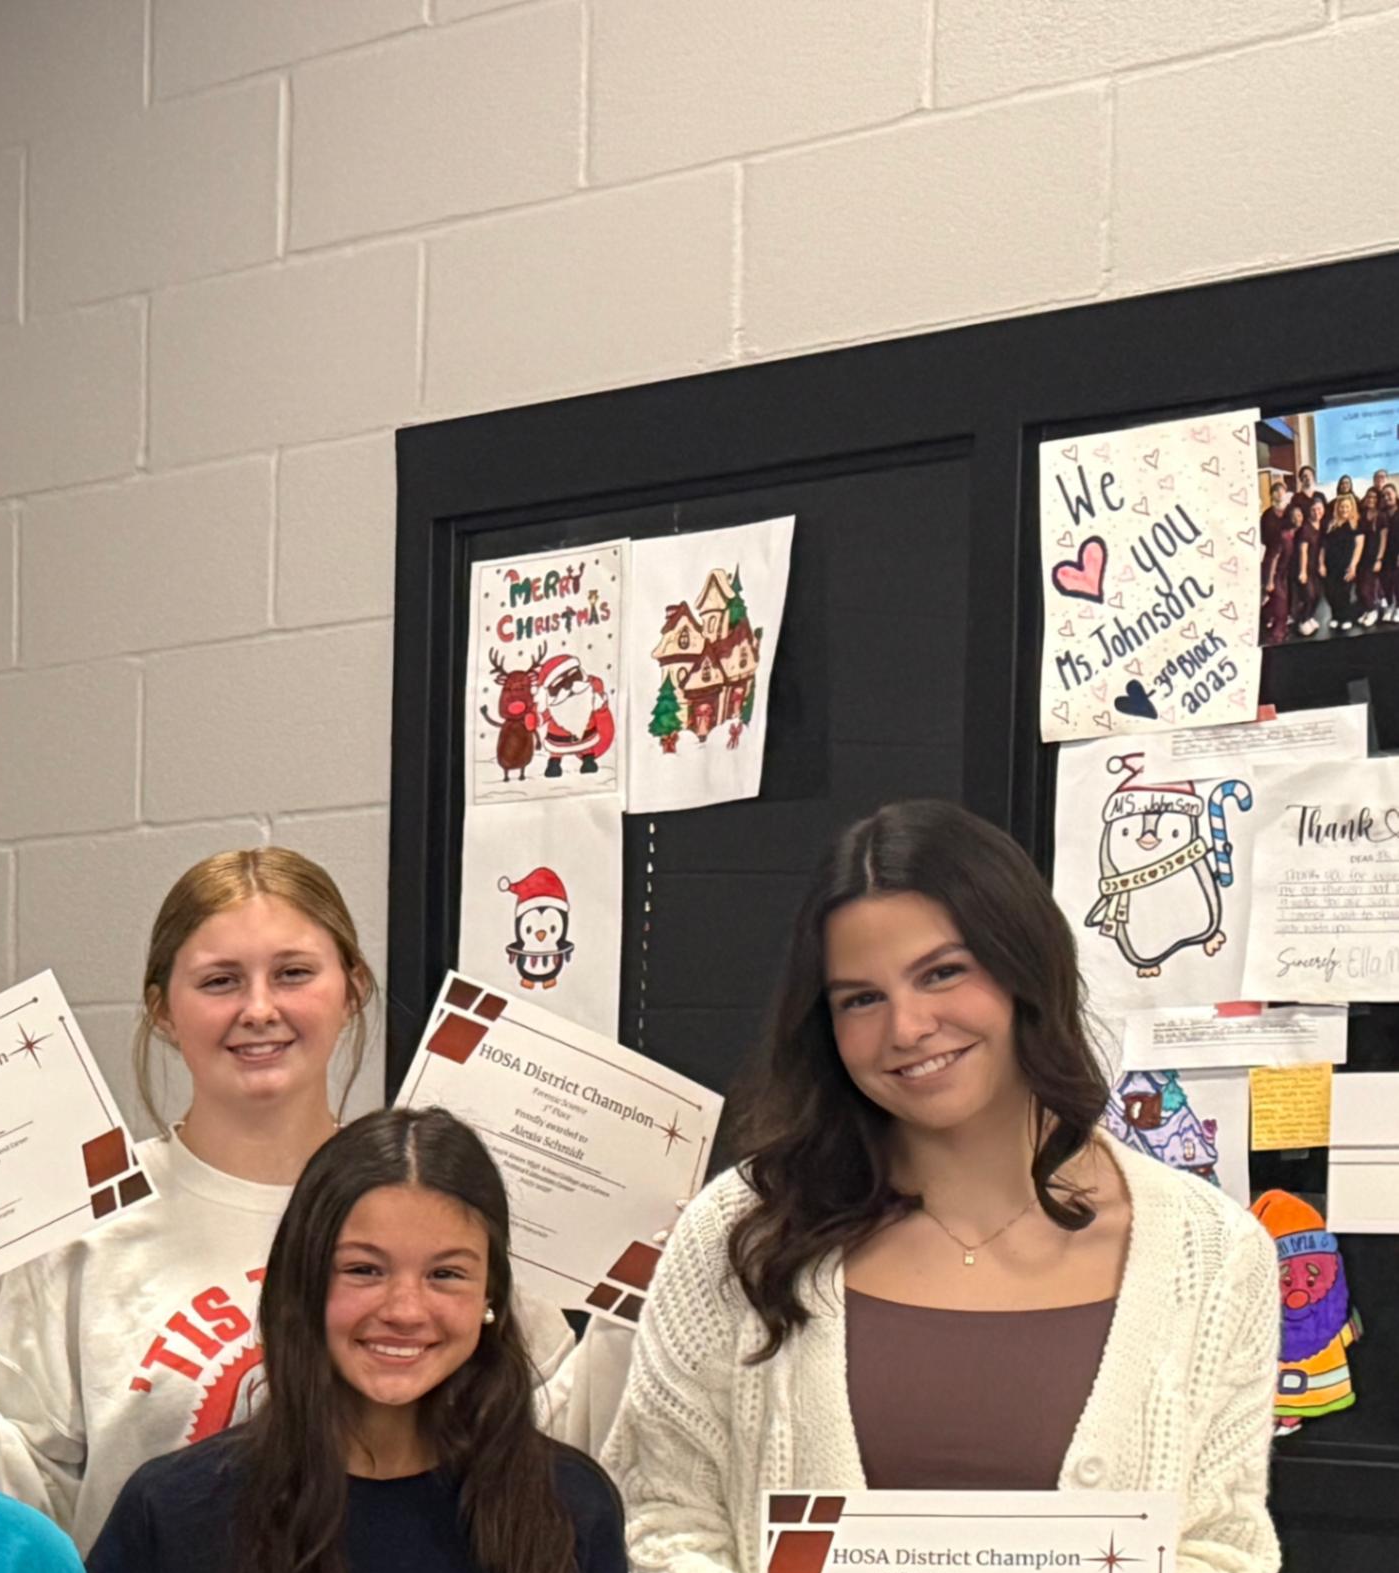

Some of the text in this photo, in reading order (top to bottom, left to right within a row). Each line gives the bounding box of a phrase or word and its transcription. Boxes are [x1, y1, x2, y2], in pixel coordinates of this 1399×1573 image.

[1056, 466, 1124, 526] We
[1130, 504, 1201, 597] you
[509, 562, 585, 608] MERRY
[497, 602, 611, 642] CHRISTMAS
[1056, 577, 1214, 691] Ms. Johnson
[1181, 656, 1238, 714] 2025
[1287, 804, 1375, 847] Thank
[479, 1043, 654, 1128] HOSA District Champion
[128, 1286, 251, 1393] 'TIS
[832, 1548, 1080, 1570] HOSA District Champion
